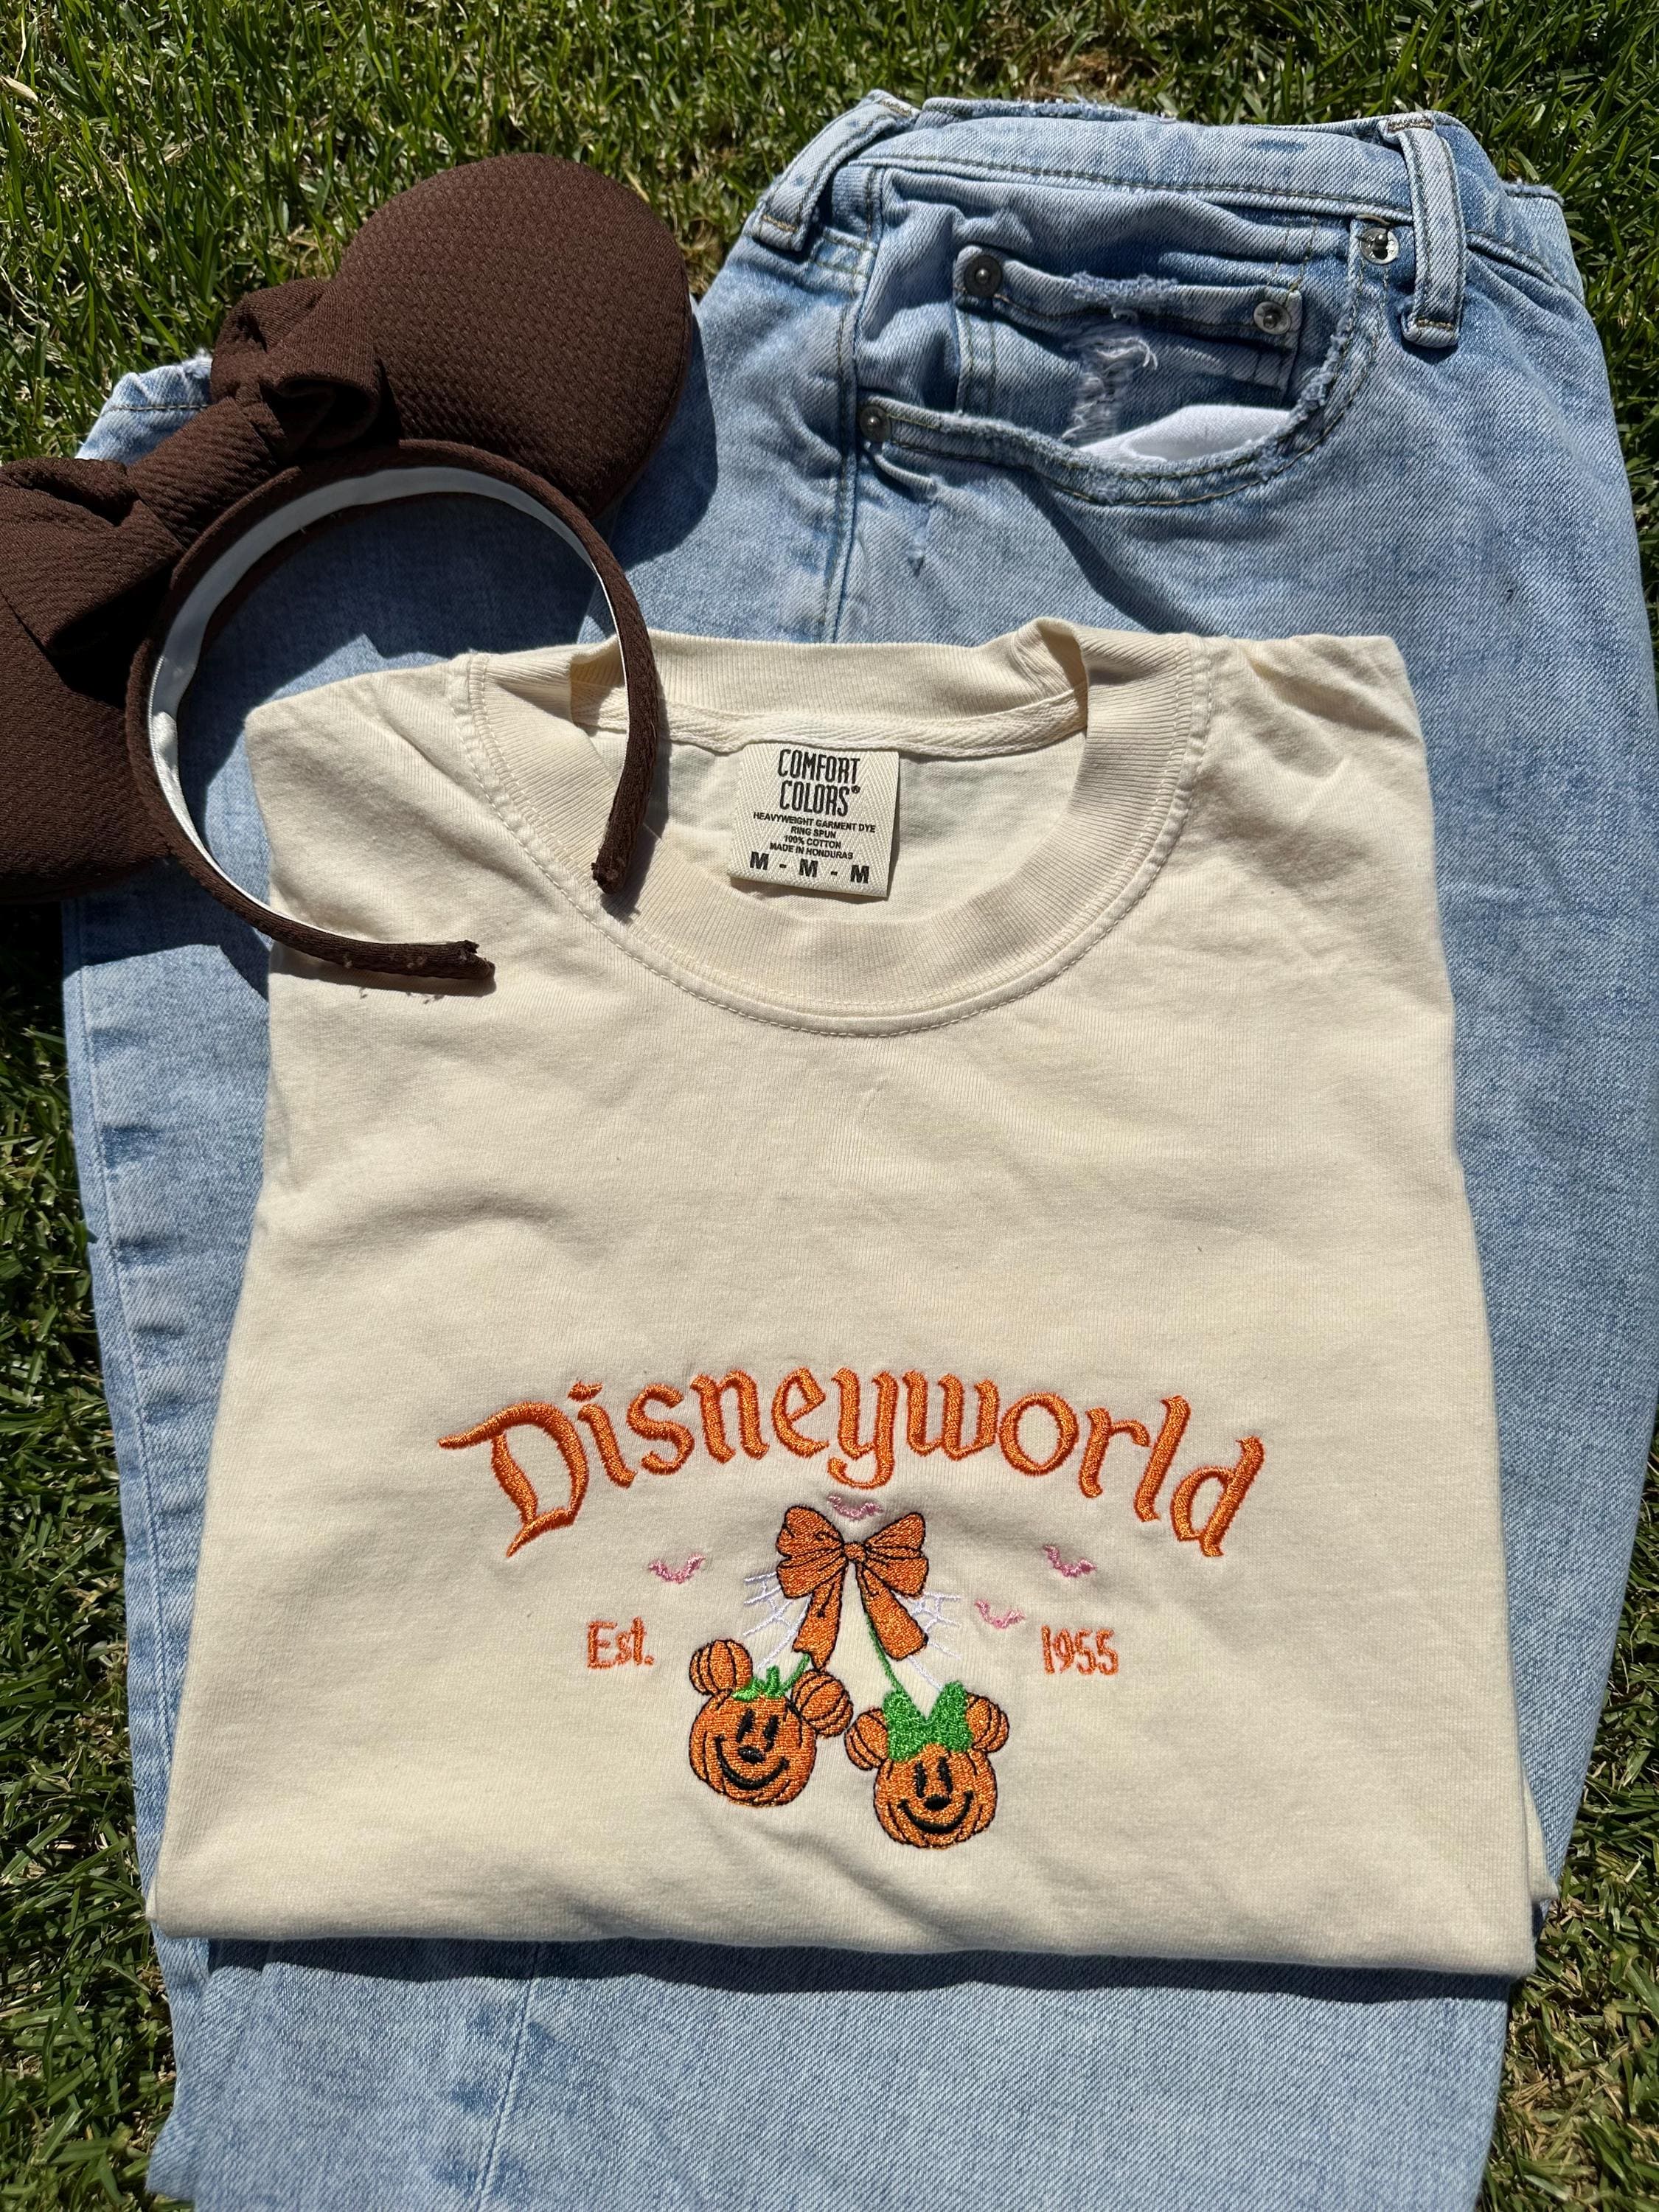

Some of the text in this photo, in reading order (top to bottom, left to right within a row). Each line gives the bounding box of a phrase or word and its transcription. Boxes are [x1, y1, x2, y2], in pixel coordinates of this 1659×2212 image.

[777, 749, 860, 784] COMFORT
[753, 812, 876, 833] HEAVYWEIGHT GARMENT DYE
[790, 826, 836, 839] RING SPUN
[769, 842, 854, 860] MADE IN HONDURAS
[784, 835, 841, 849] 100% COTTON
[749, 852, 769, 871] M
[799, 858, 818, 878] M
[850, 864, 870, 884] M
[438, 1366, 1265, 1558] Disneyworld
[587, 1615, 655, 1669] Est.
[1040, 1625, 1119, 1675] 1955
